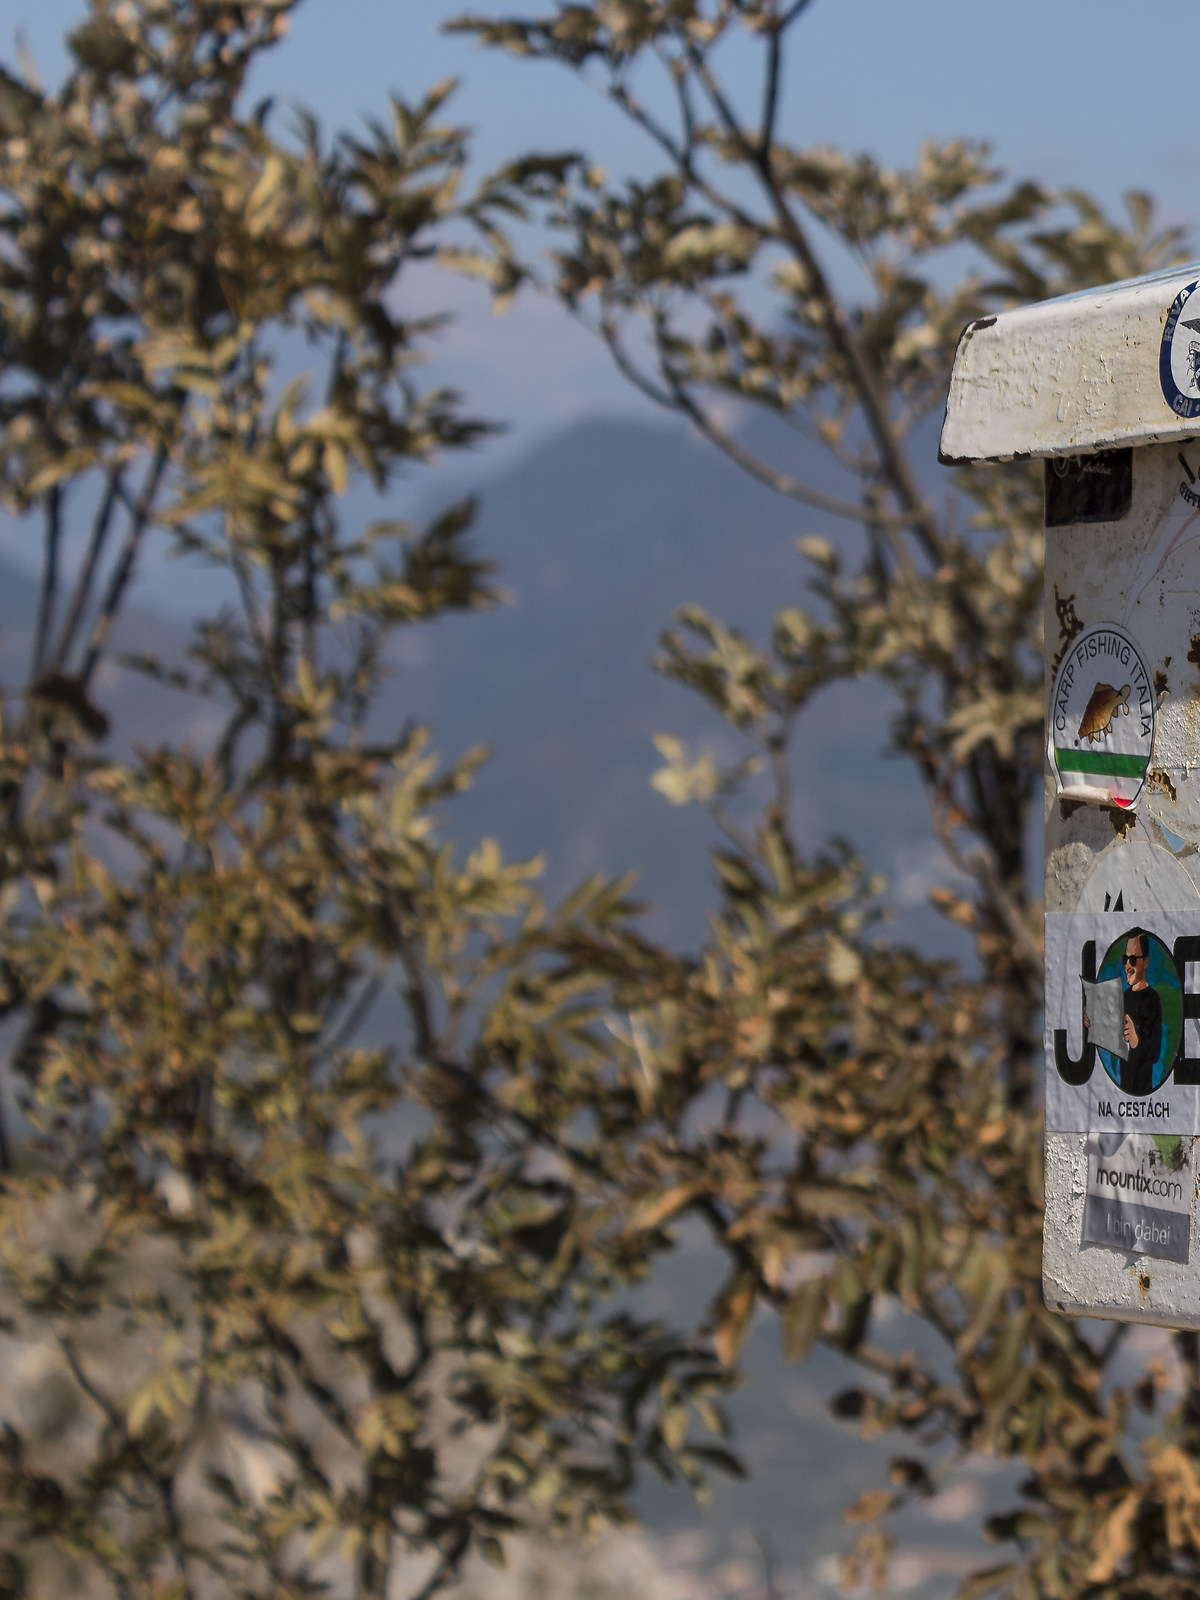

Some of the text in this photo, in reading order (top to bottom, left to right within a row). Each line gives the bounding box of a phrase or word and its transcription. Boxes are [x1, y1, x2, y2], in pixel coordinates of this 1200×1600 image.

[1163, 289, 1191, 342] RIVA
[1055, 636, 1151, 738] CARP FISHING ITALIA
[1098, 1098, 1171, 1119] NA CESTÁCH
[1096, 1163, 1182, 1200] mountix.com
[1134, 1219, 1171, 1246] dabei
